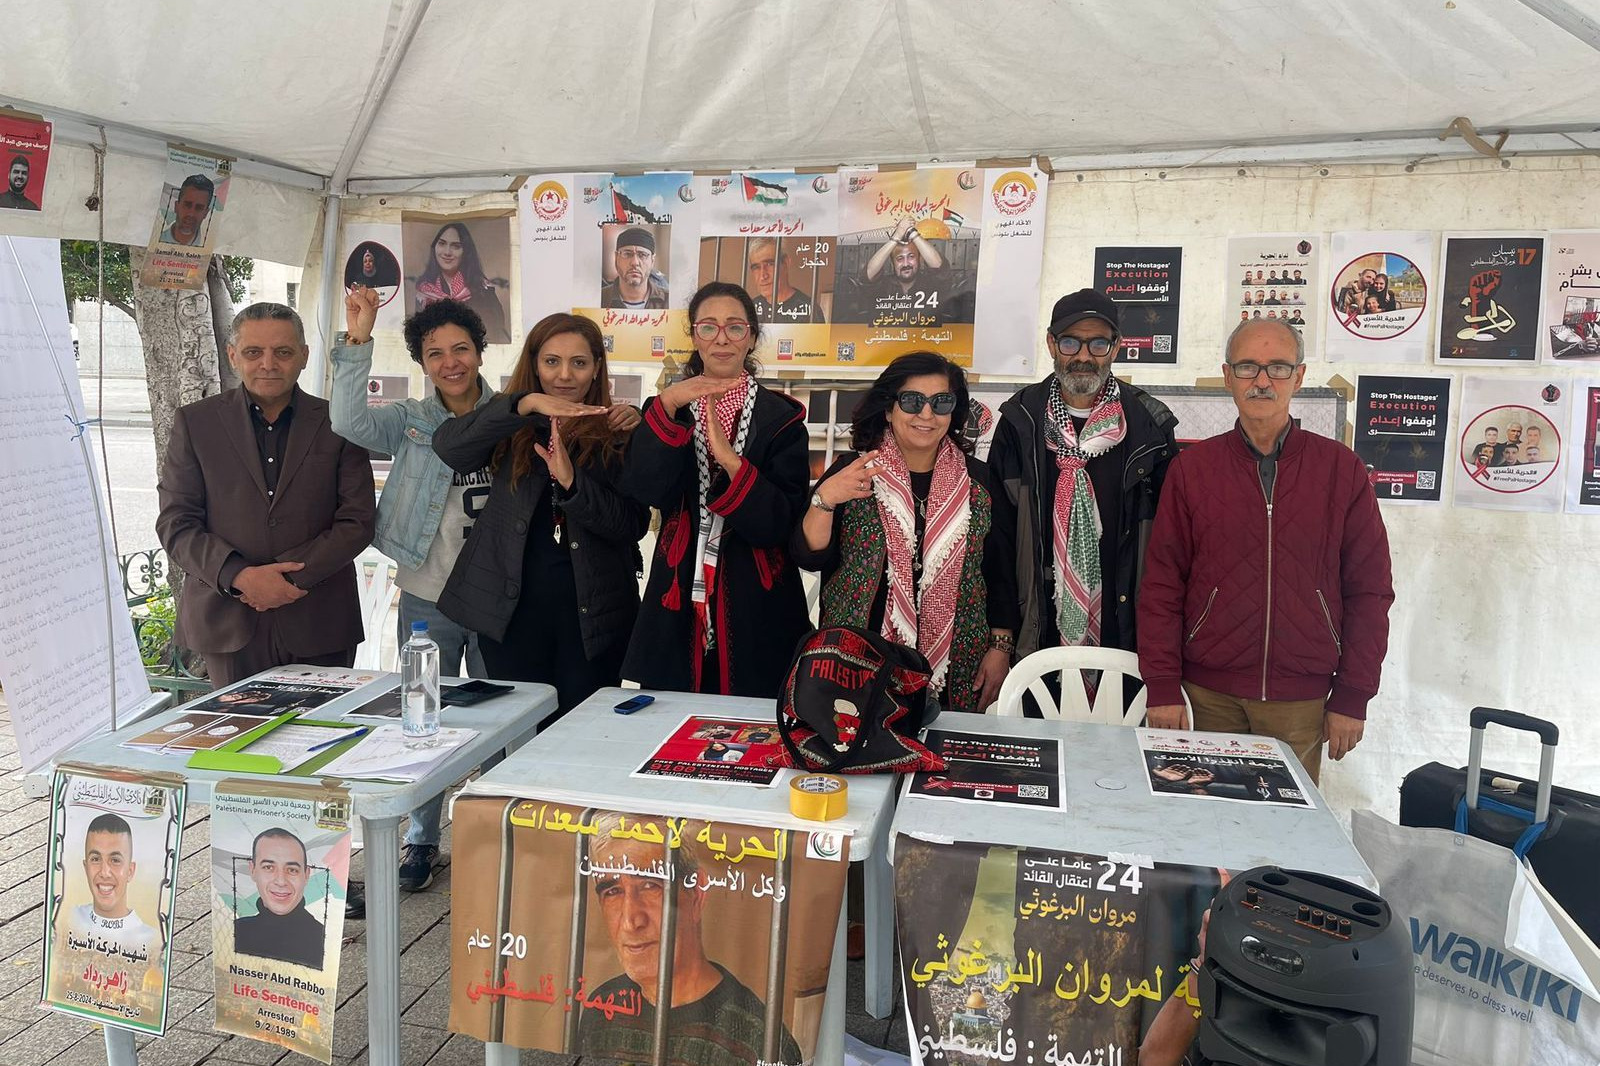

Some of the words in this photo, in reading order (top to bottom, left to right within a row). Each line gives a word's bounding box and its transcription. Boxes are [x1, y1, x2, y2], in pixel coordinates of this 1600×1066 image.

[739, 223, 766, 233] سعدات
[795, 242, 811, 256] عام
[814, 242, 829, 254] 20
[1517, 248, 1537, 266] 17
[799, 257, 829, 269] احتجاز
[1106, 262, 1122, 270] Stop
[1570, 263, 1592, 279] بشر
[1105, 270, 1169, 278] Execution
[1136, 281, 1170, 294] أوقفوا
[913, 290, 939, 309] 24
[777, 301, 811, 320] التهمة
[872, 310, 909, 330] البرغوثي
[909, 312, 937, 326] مروان
[864, 330, 908, 345] فلسطيني
[920, 329, 953, 345] التهمة
[1370, 392, 1388, 400] Stop
[1370, 401, 1436, 411] Execution
[1402, 414, 1436, 427] أوقفوا
[215, 804, 253, 815] Palestinian
[253, 807, 286, 818] Prisoner's
[286, 811, 311, 822] Society
[509, 802, 600, 837] سعدات
[695, 821, 788, 863] الحرية
[578, 854, 677, 883] الفلسطينيين
[1023, 870, 1055, 885] القائد
[1096, 860, 1143, 895] 24
[682, 868, 746, 893] الأسرى
[751, 873, 788, 903] وكل
[1055, 874, 1093, 890] اعتقال
[1019, 887, 1086, 921] البرغوثي
[1088, 898, 1138, 929] مروان
[68, 931, 96, 951] الأسيرة
[96, 936, 121, 957] الحركة
[466, 928, 494, 955] عام
[500, 932, 528, 960] 20
[121, 944, 148, 963] شهيد
[910, 932, 1044, 994] البرغوثي
[83, 963, 103, 990] رداد
[103, 970, 128, 995] زاهر
[229, 964, 269, 980] Nasser
[270, 972, 291, 986] Abd
[293, 977, 325, 997] Rabbo
[1054, 959, 1164, 1009] لمروان
[465, 969, 556, 1006] فلسطيني
[1422, 965, 1466, 995] deserves
[1468, 986, 1480, 1000] to
[1481, 991, 1507, 1014] dress
[1509, 1007, 1535, 1024] well
[233, 983, 259, 999] Life
[261, 989, 319, 1016] Sentence
[575, 977, 642, 1021] التهمة
[257, 1007, 295, 1025] Arrested
[254, 1020, 297, 1039] 9/2/1989
